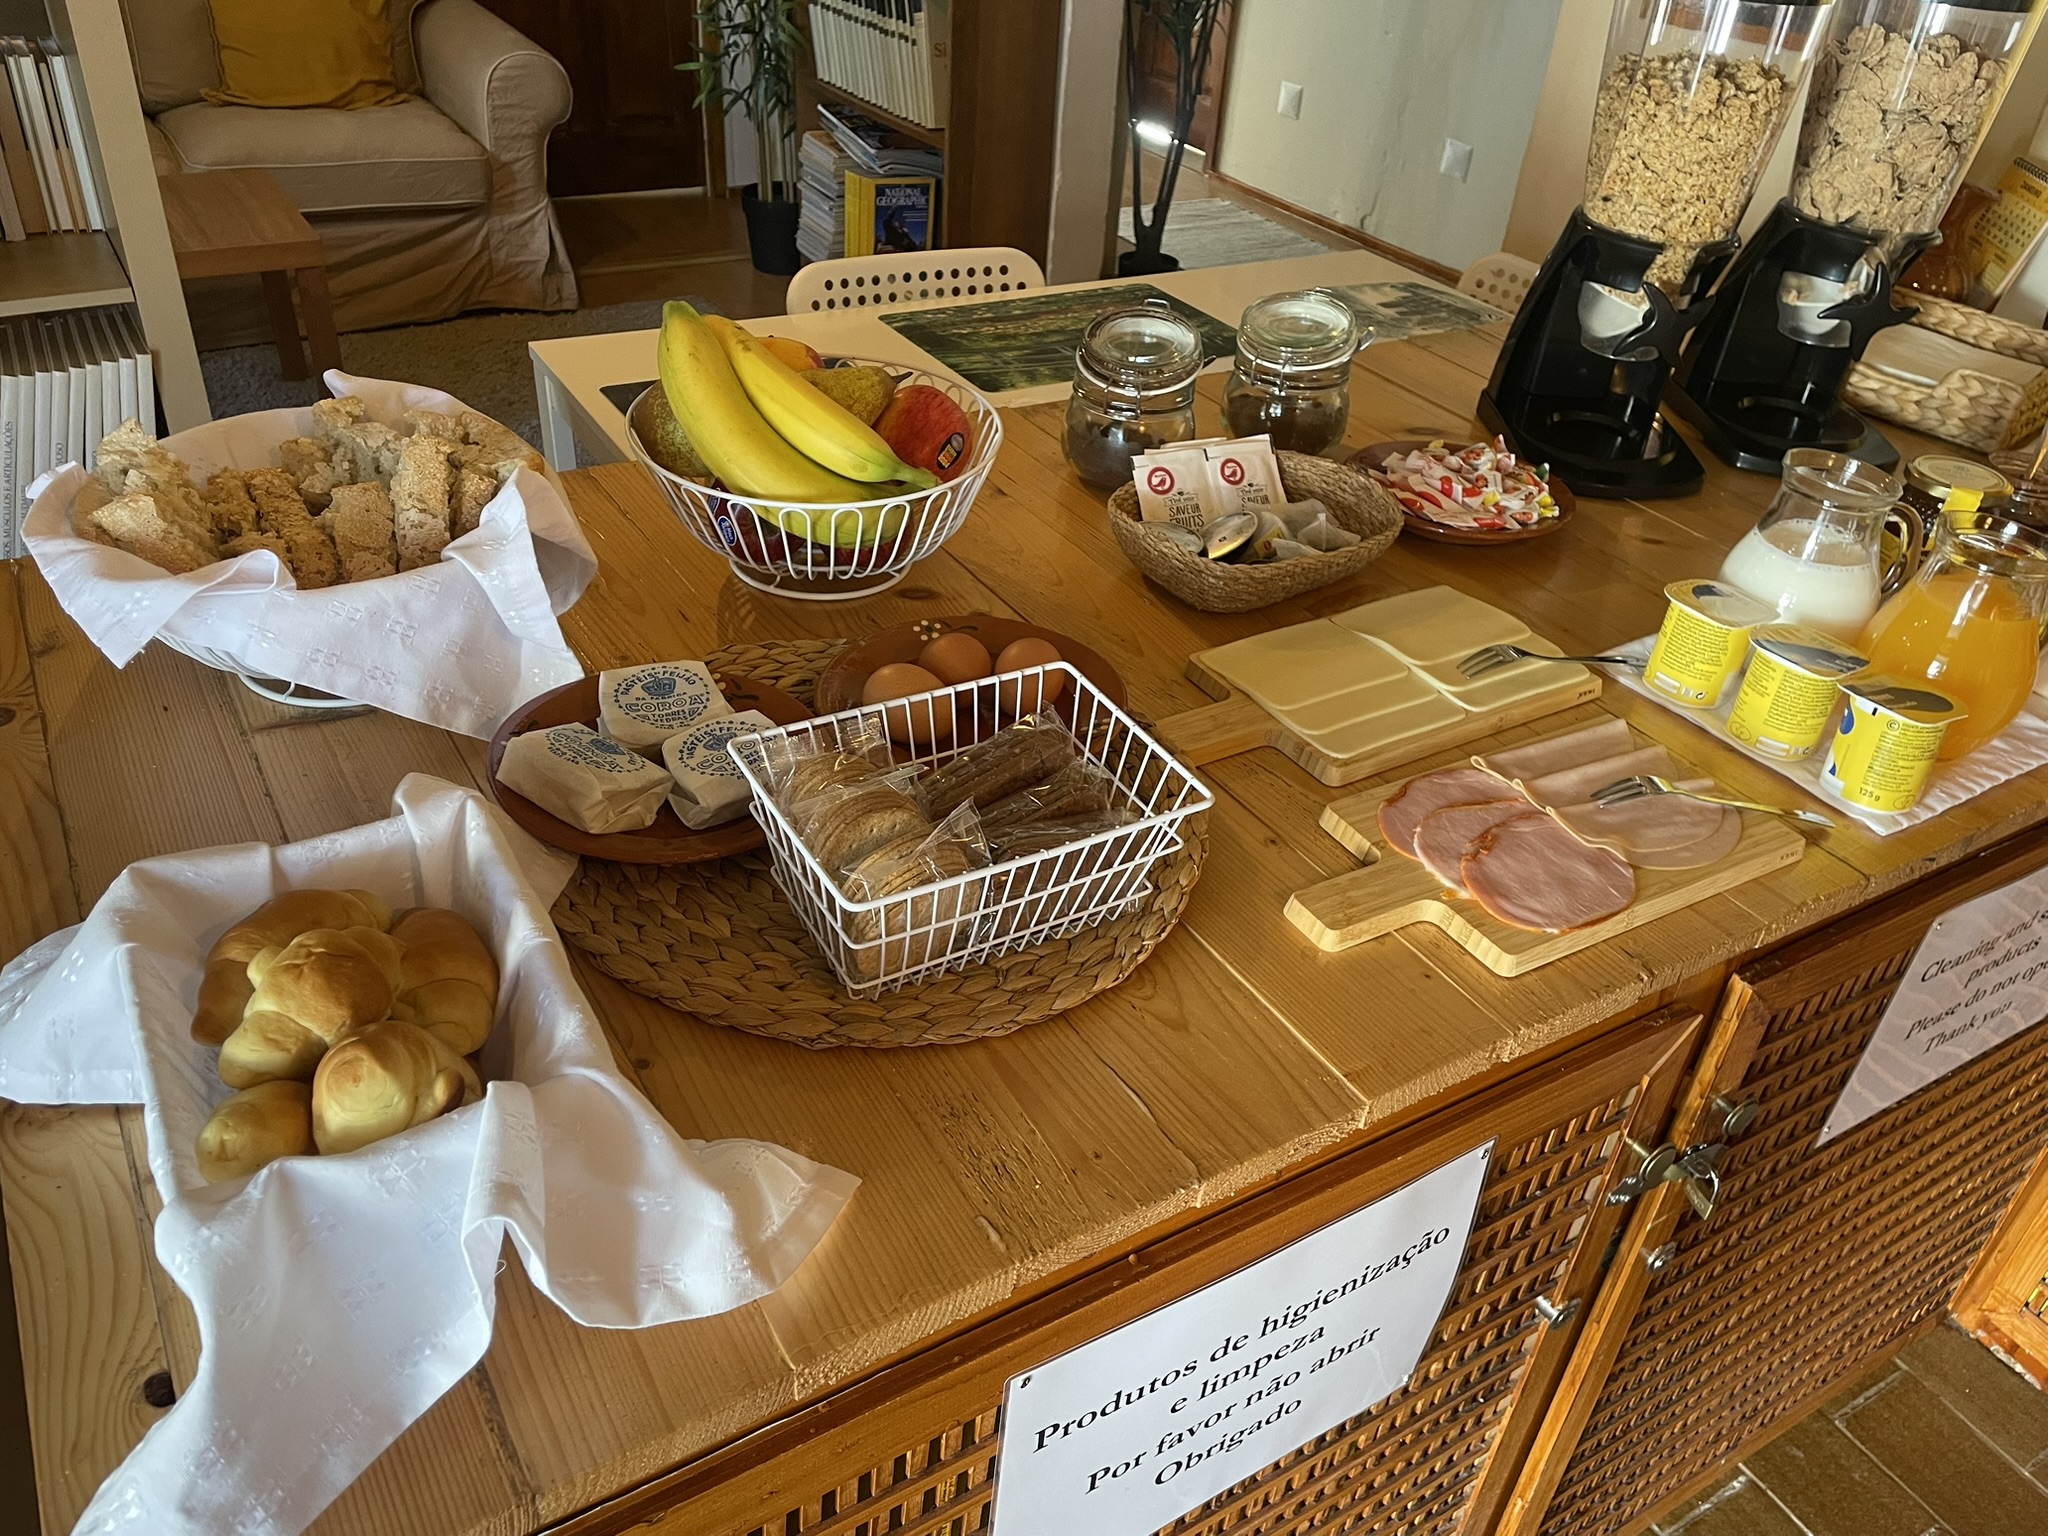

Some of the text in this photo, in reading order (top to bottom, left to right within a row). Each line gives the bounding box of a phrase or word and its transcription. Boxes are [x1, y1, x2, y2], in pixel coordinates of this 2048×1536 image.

[876, 196, 928, 206] GEOGRAPHIC
[884, 187, 921, 197] NATIONAL
[4, 421, 14, 482] ARTICULAÇÕES
[1169, 503, 1202, 518] SAVEUR
[1170, 514, 1204, 529] RUITS
[662, 670, 697, 686] FEIJÃO
[624, 694, 704, 712] COROA
[651, 709, 687, 718] TORRES
[652, 715, 689, 723] VEDRAS
[1859, 787, 1874, 798] 125
[1920, 909, 2048, 983] Cleaning and s
[1963, 935, 2042, 989] products
[1904, 961, 2048, 1041] Please do not ope
[1922, 1000, 2013, 1055] Thank you
[1032, 1227, 1450, 1454] Produtos de higienização
[1170, 1326, 1325, 1414] e limpeza
[1085, 1327, 1381, 1495] Por favor não abrir
[1154, 1399, 1302, 1485] Obrigado
